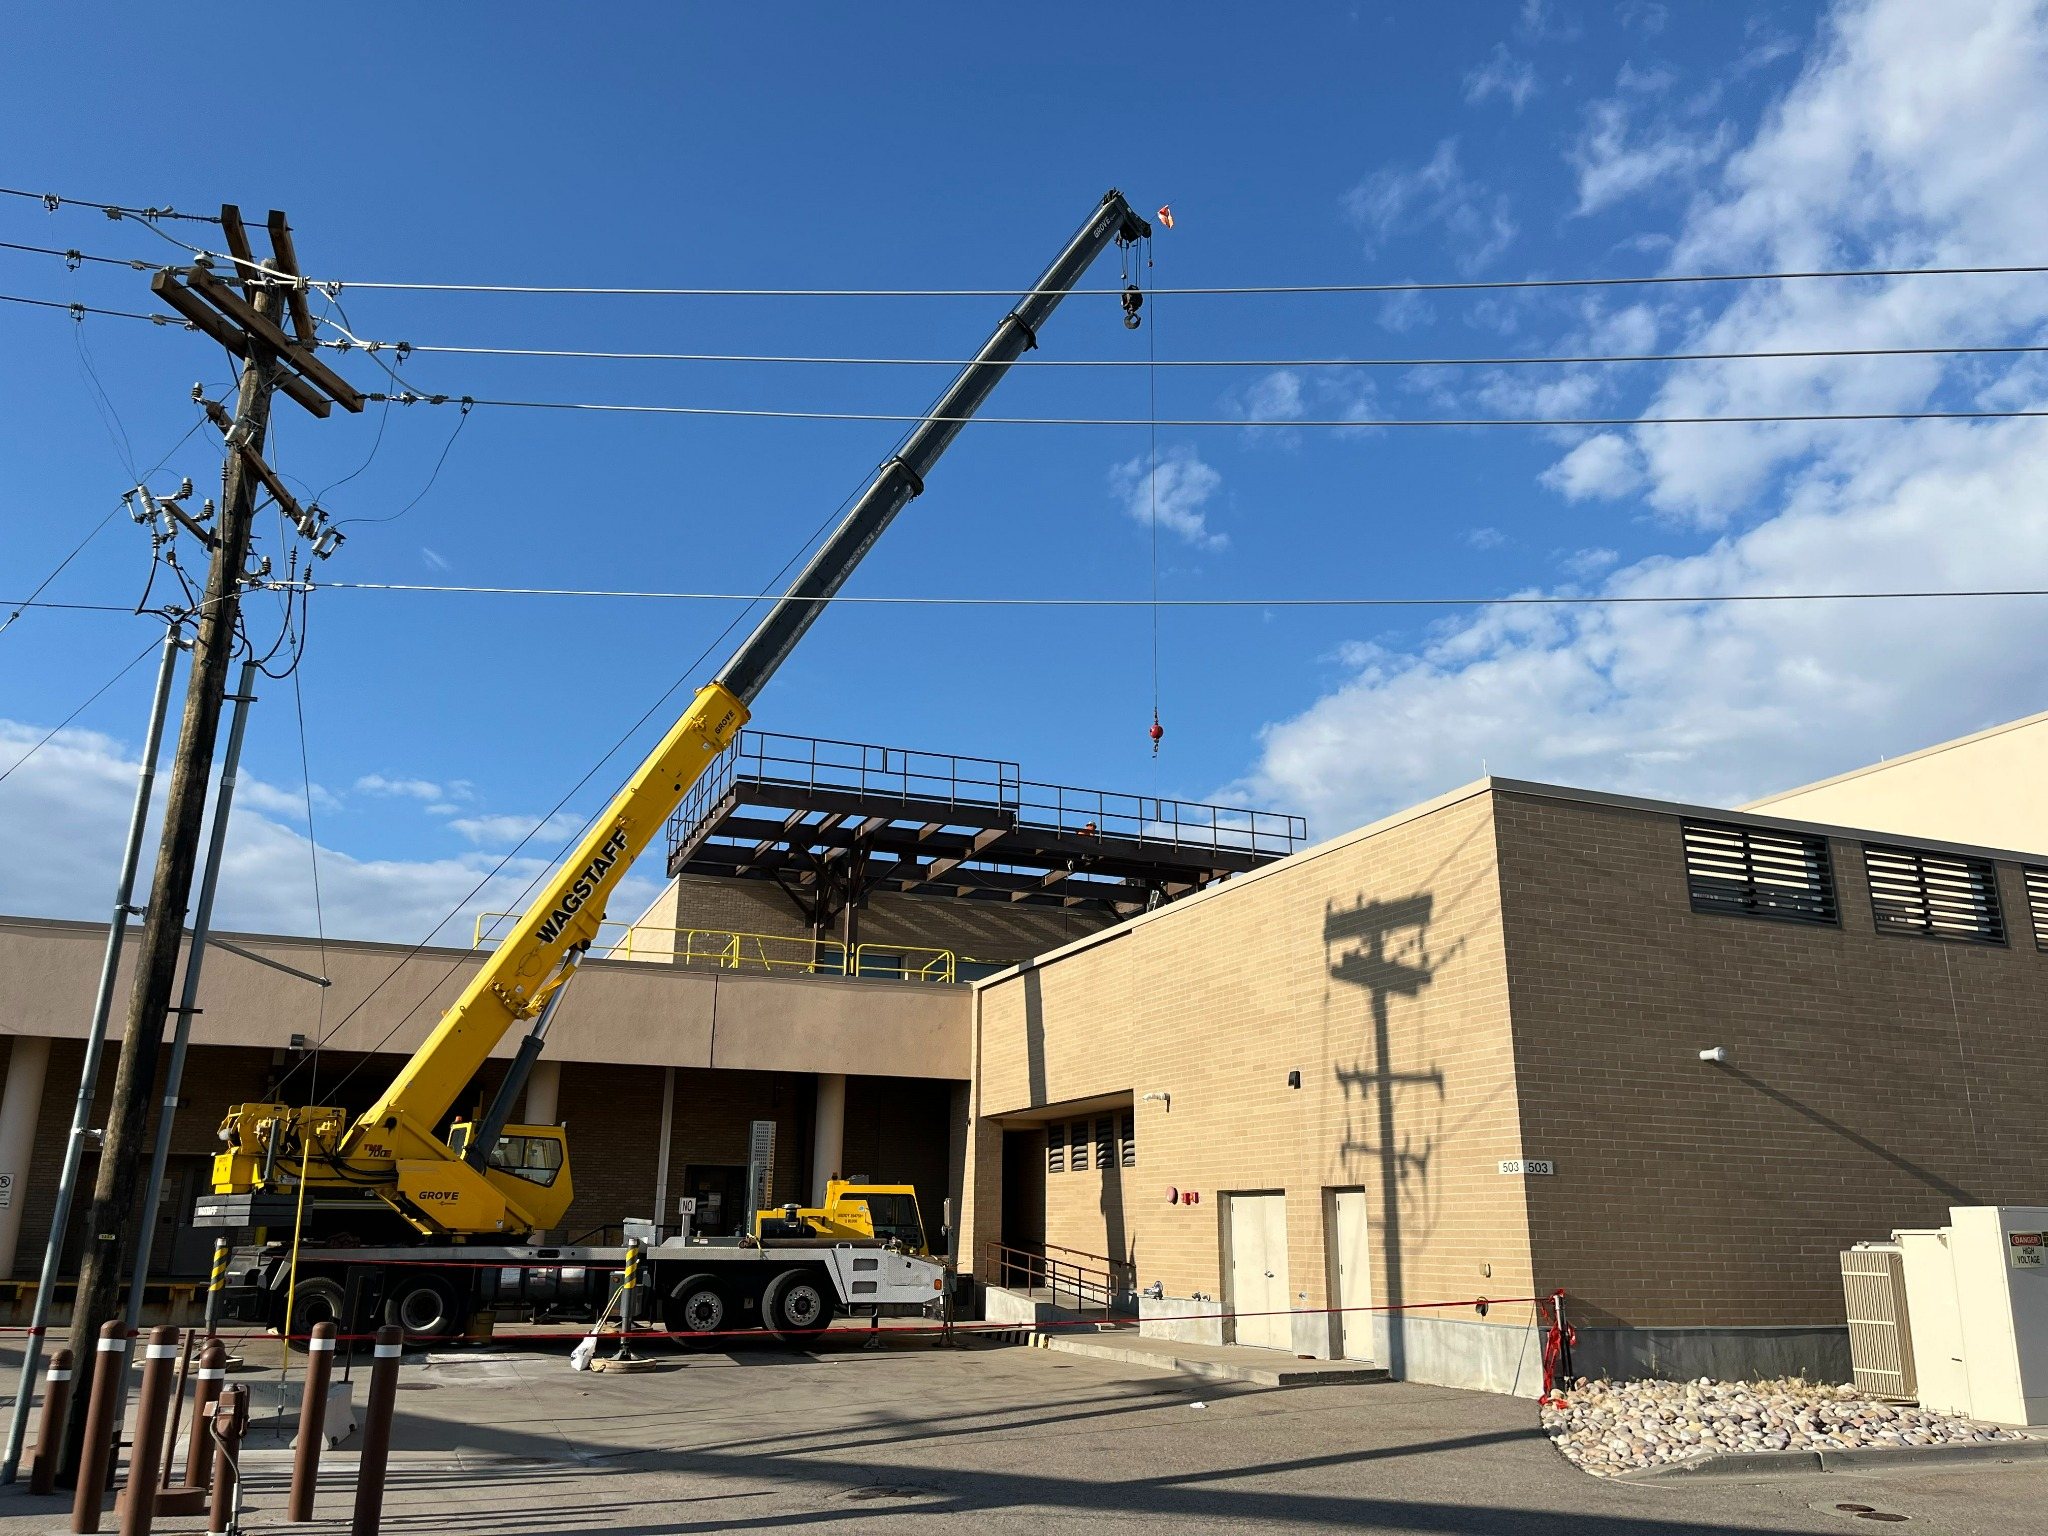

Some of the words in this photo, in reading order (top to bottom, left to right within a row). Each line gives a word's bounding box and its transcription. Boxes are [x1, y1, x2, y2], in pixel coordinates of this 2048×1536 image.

[1093, 216, 1110, 238] GROVE
[715, 710, 735, 734] GROVE
[535, 828, 628, 945] WAGSTAFF
[1503, 1162, 1519, 1172] 503
[1528, 1162, 1548, 1173] 503
[418, 1191, 460, 1201] GROVE
[682, 1200, 693, 1212] NO
[2022, 1246, 2035, 1255] HIGH
[2016, 1255, 2041, 1264] VOLTAGE
